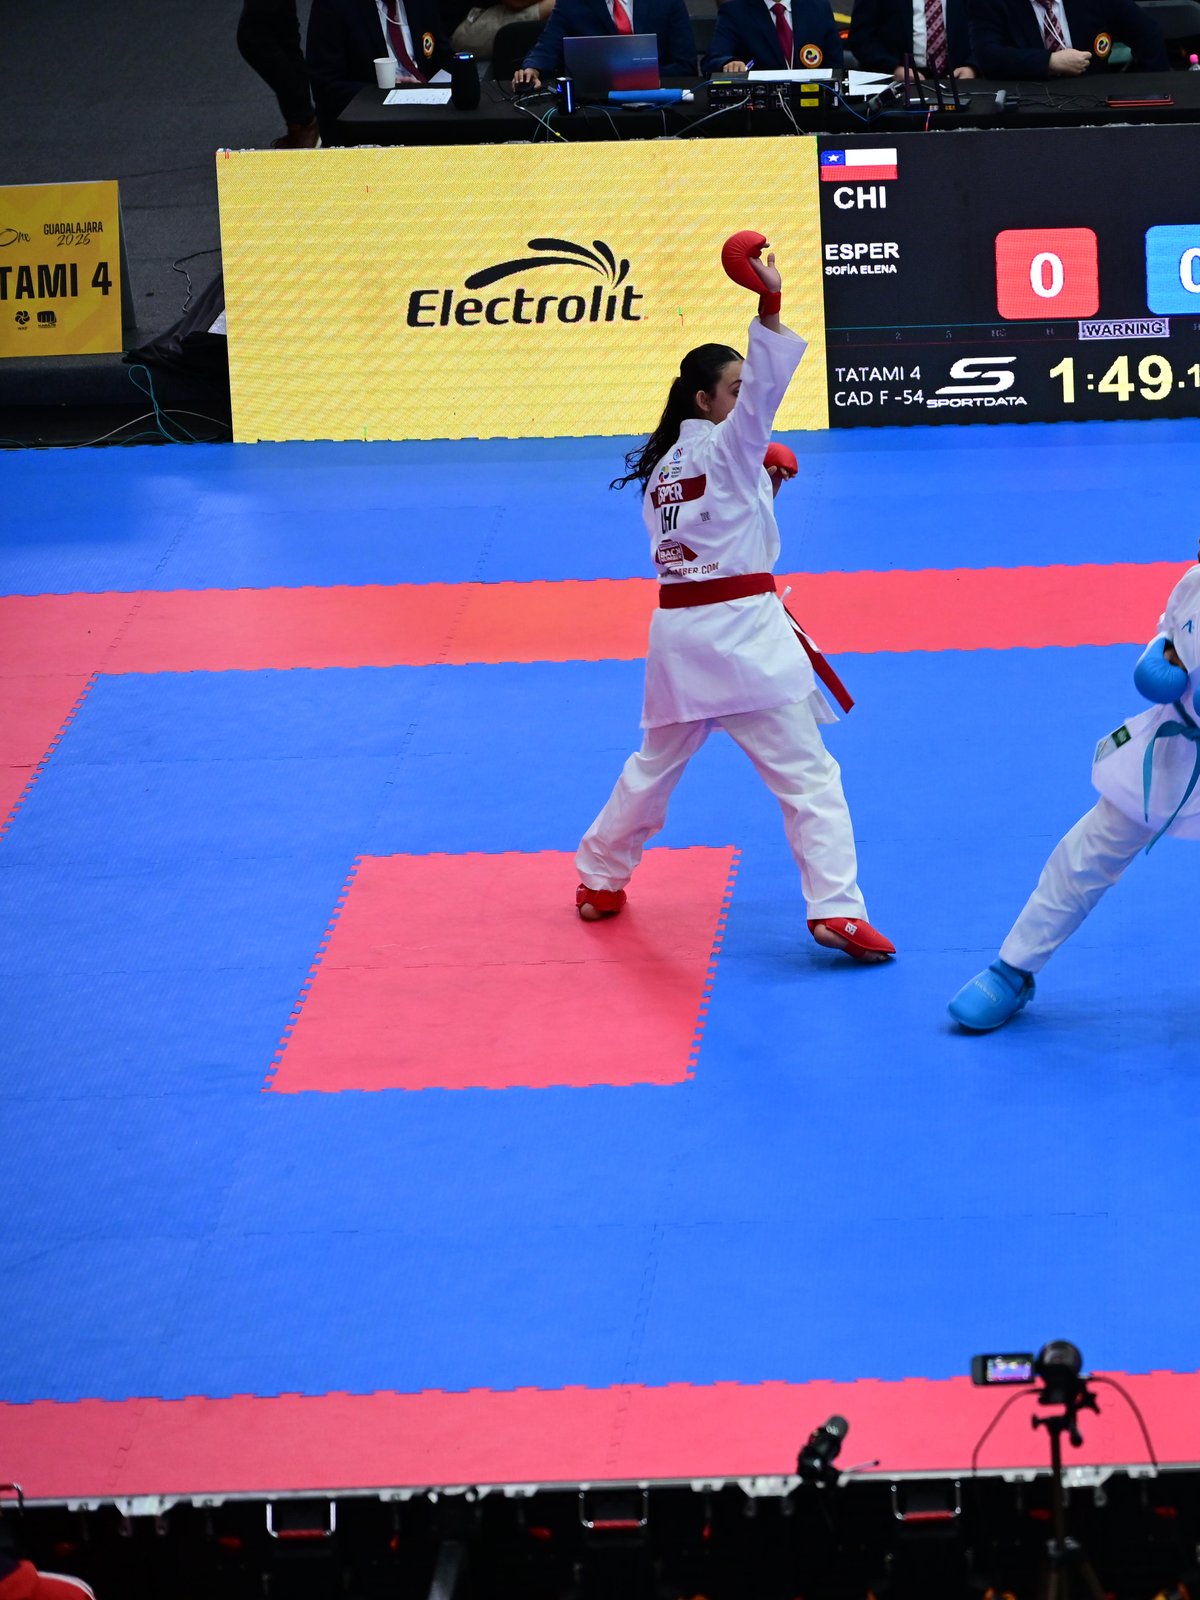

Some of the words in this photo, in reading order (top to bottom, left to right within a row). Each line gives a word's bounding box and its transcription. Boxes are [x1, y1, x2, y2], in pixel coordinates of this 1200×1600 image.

[833, 186, 887, 209] CHI
[43, 221, 104, 235] GUADALAJARA
[56, 233, 91, 247] 2026
[824, 242, 900, 260] ESPER
[859, 264, 898, 274] ELENA
[1030, 252, 1064, 298] 0
[91, 262, 113, 296] 4
[406, 285, 644, 328] Electrolit
[1085, 321, 1164, 336] WARNING
[835, 366, 904, 382] TATAMI
[910, 366, 921, 380] 4
[834, 391, 873, 406] CAD
[880, 391, 888, 405] F
[895, 389, 924, 405] -54
[926, 396, 1027, 408] SPORTDATA
